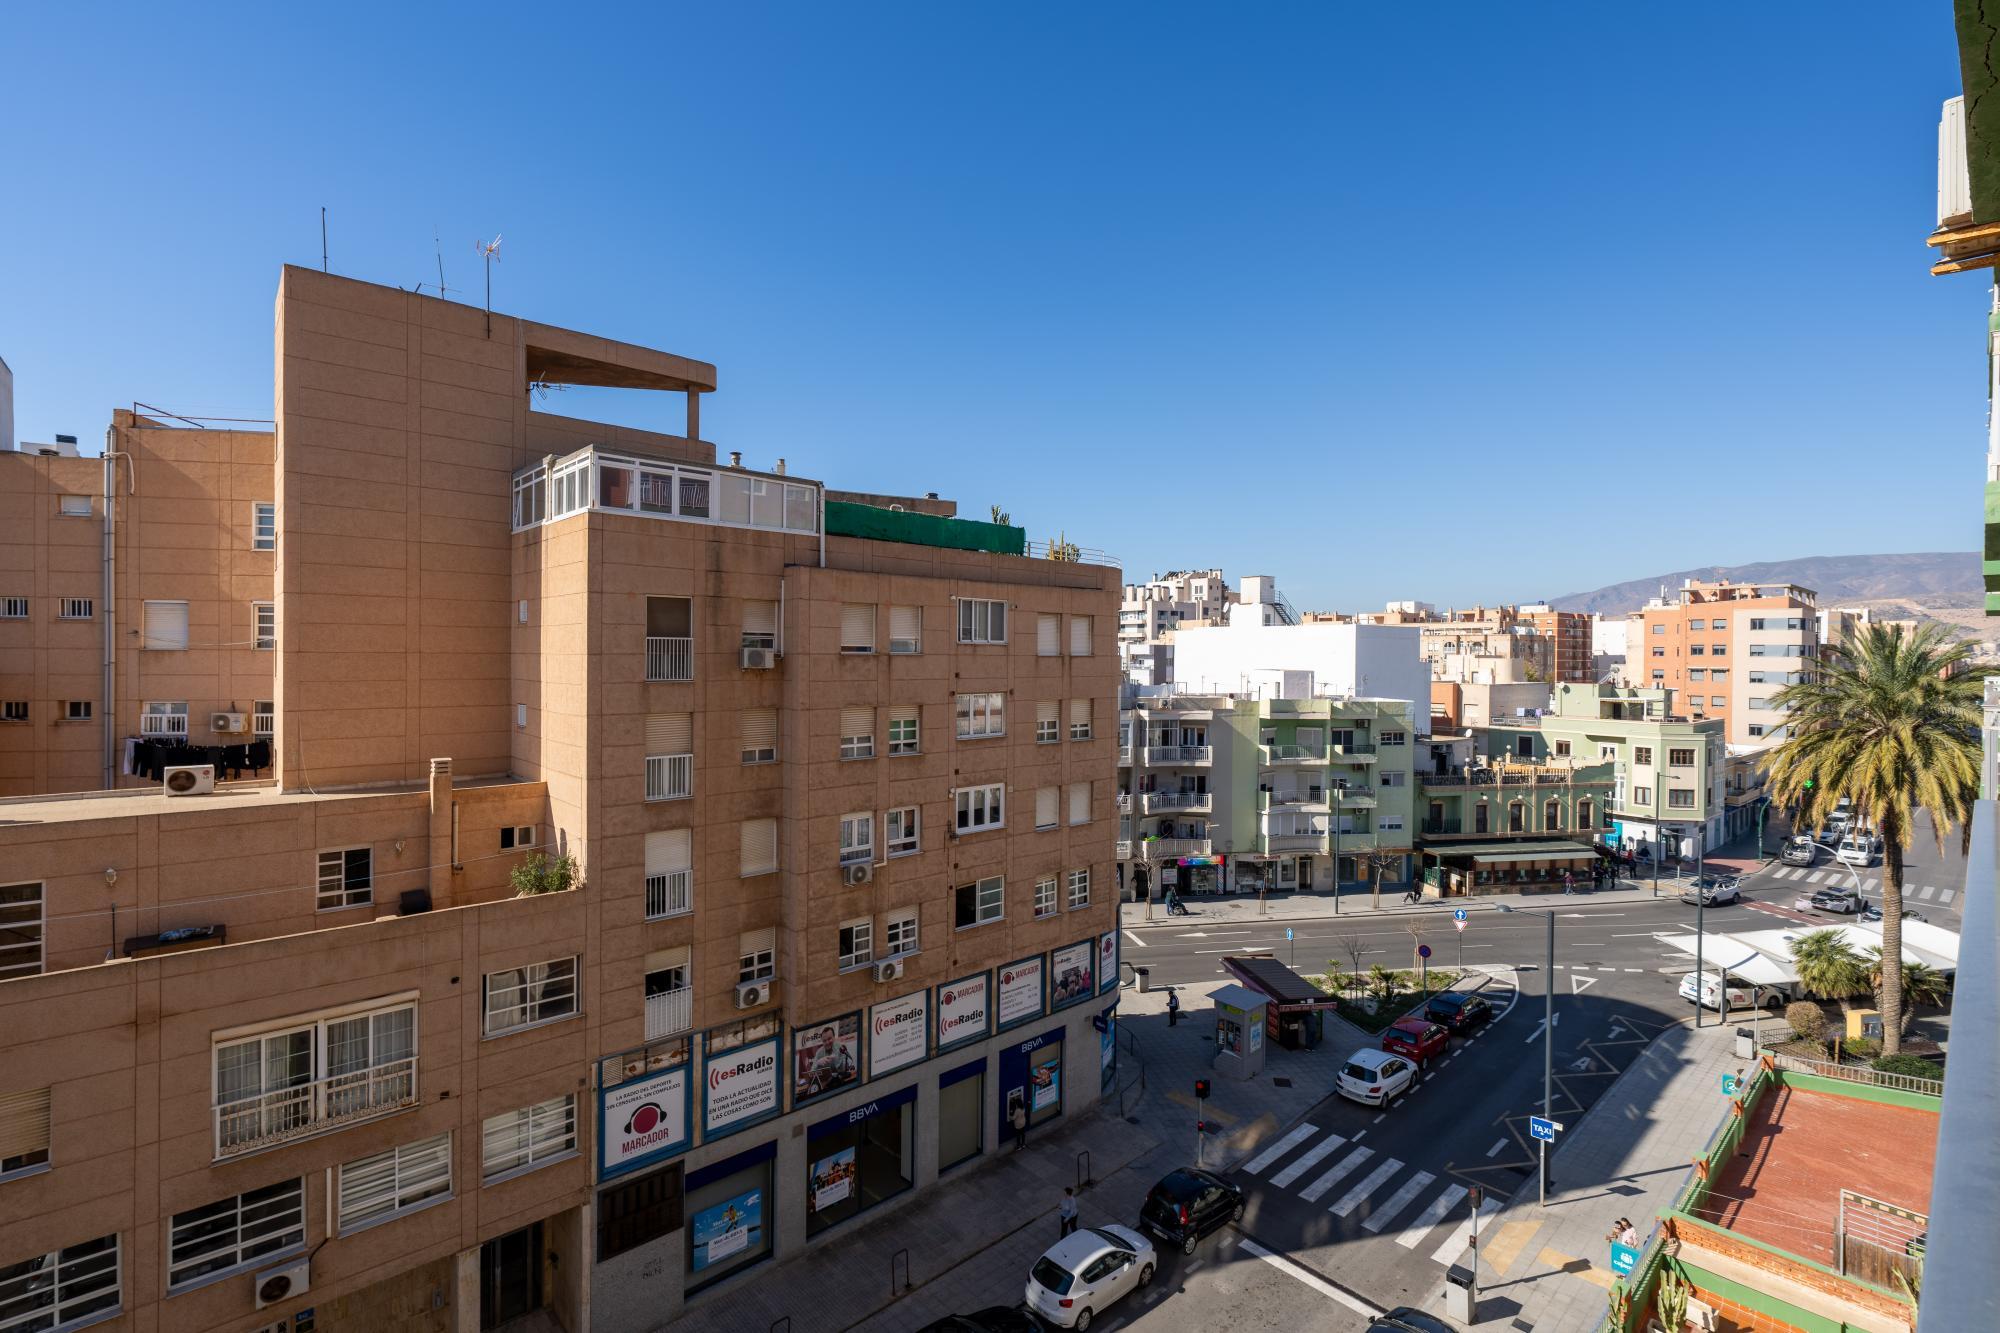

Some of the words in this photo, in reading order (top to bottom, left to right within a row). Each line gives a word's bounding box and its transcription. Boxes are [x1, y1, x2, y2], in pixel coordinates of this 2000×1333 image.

[883, 1008, 923, 1028] esRadio
[948, 1009, 984, 1028] esRadio
[1021, 1036, 1043, 1053] BBVA
[721, 1056, 774, 1080] esRadio
[623, 1090, 639, 1099] RADIO
[640, 1086, 650, 1094] DEL
[650, 1080, 672, 1090] DEPORTE
[653, 1083, 681, 1095] COMPLEJOS
[713, 1095, 729, 1105] TODA
[737, 1080, 772, 1097] ACTUALIDAD
[712, 1112, 723, 1121] LAS
[723, 1107, 742, 1117] COSAS
[742, 1101, 759, 1110] COMO
[760, 1095, 771, 1104] SON
[717, 1103, 730, 1112] UNA
[730, 1096, 748, 1107] RADIO
[748, 1092, 760, 1100] QUE
[761, 1087, 773, 1096] DICE
[849, 1102, 879, 1123] BBVA
[1533, 1124, 1552, 1136] TAXI
[622, 1127, 669, 1154] MARCADOR
